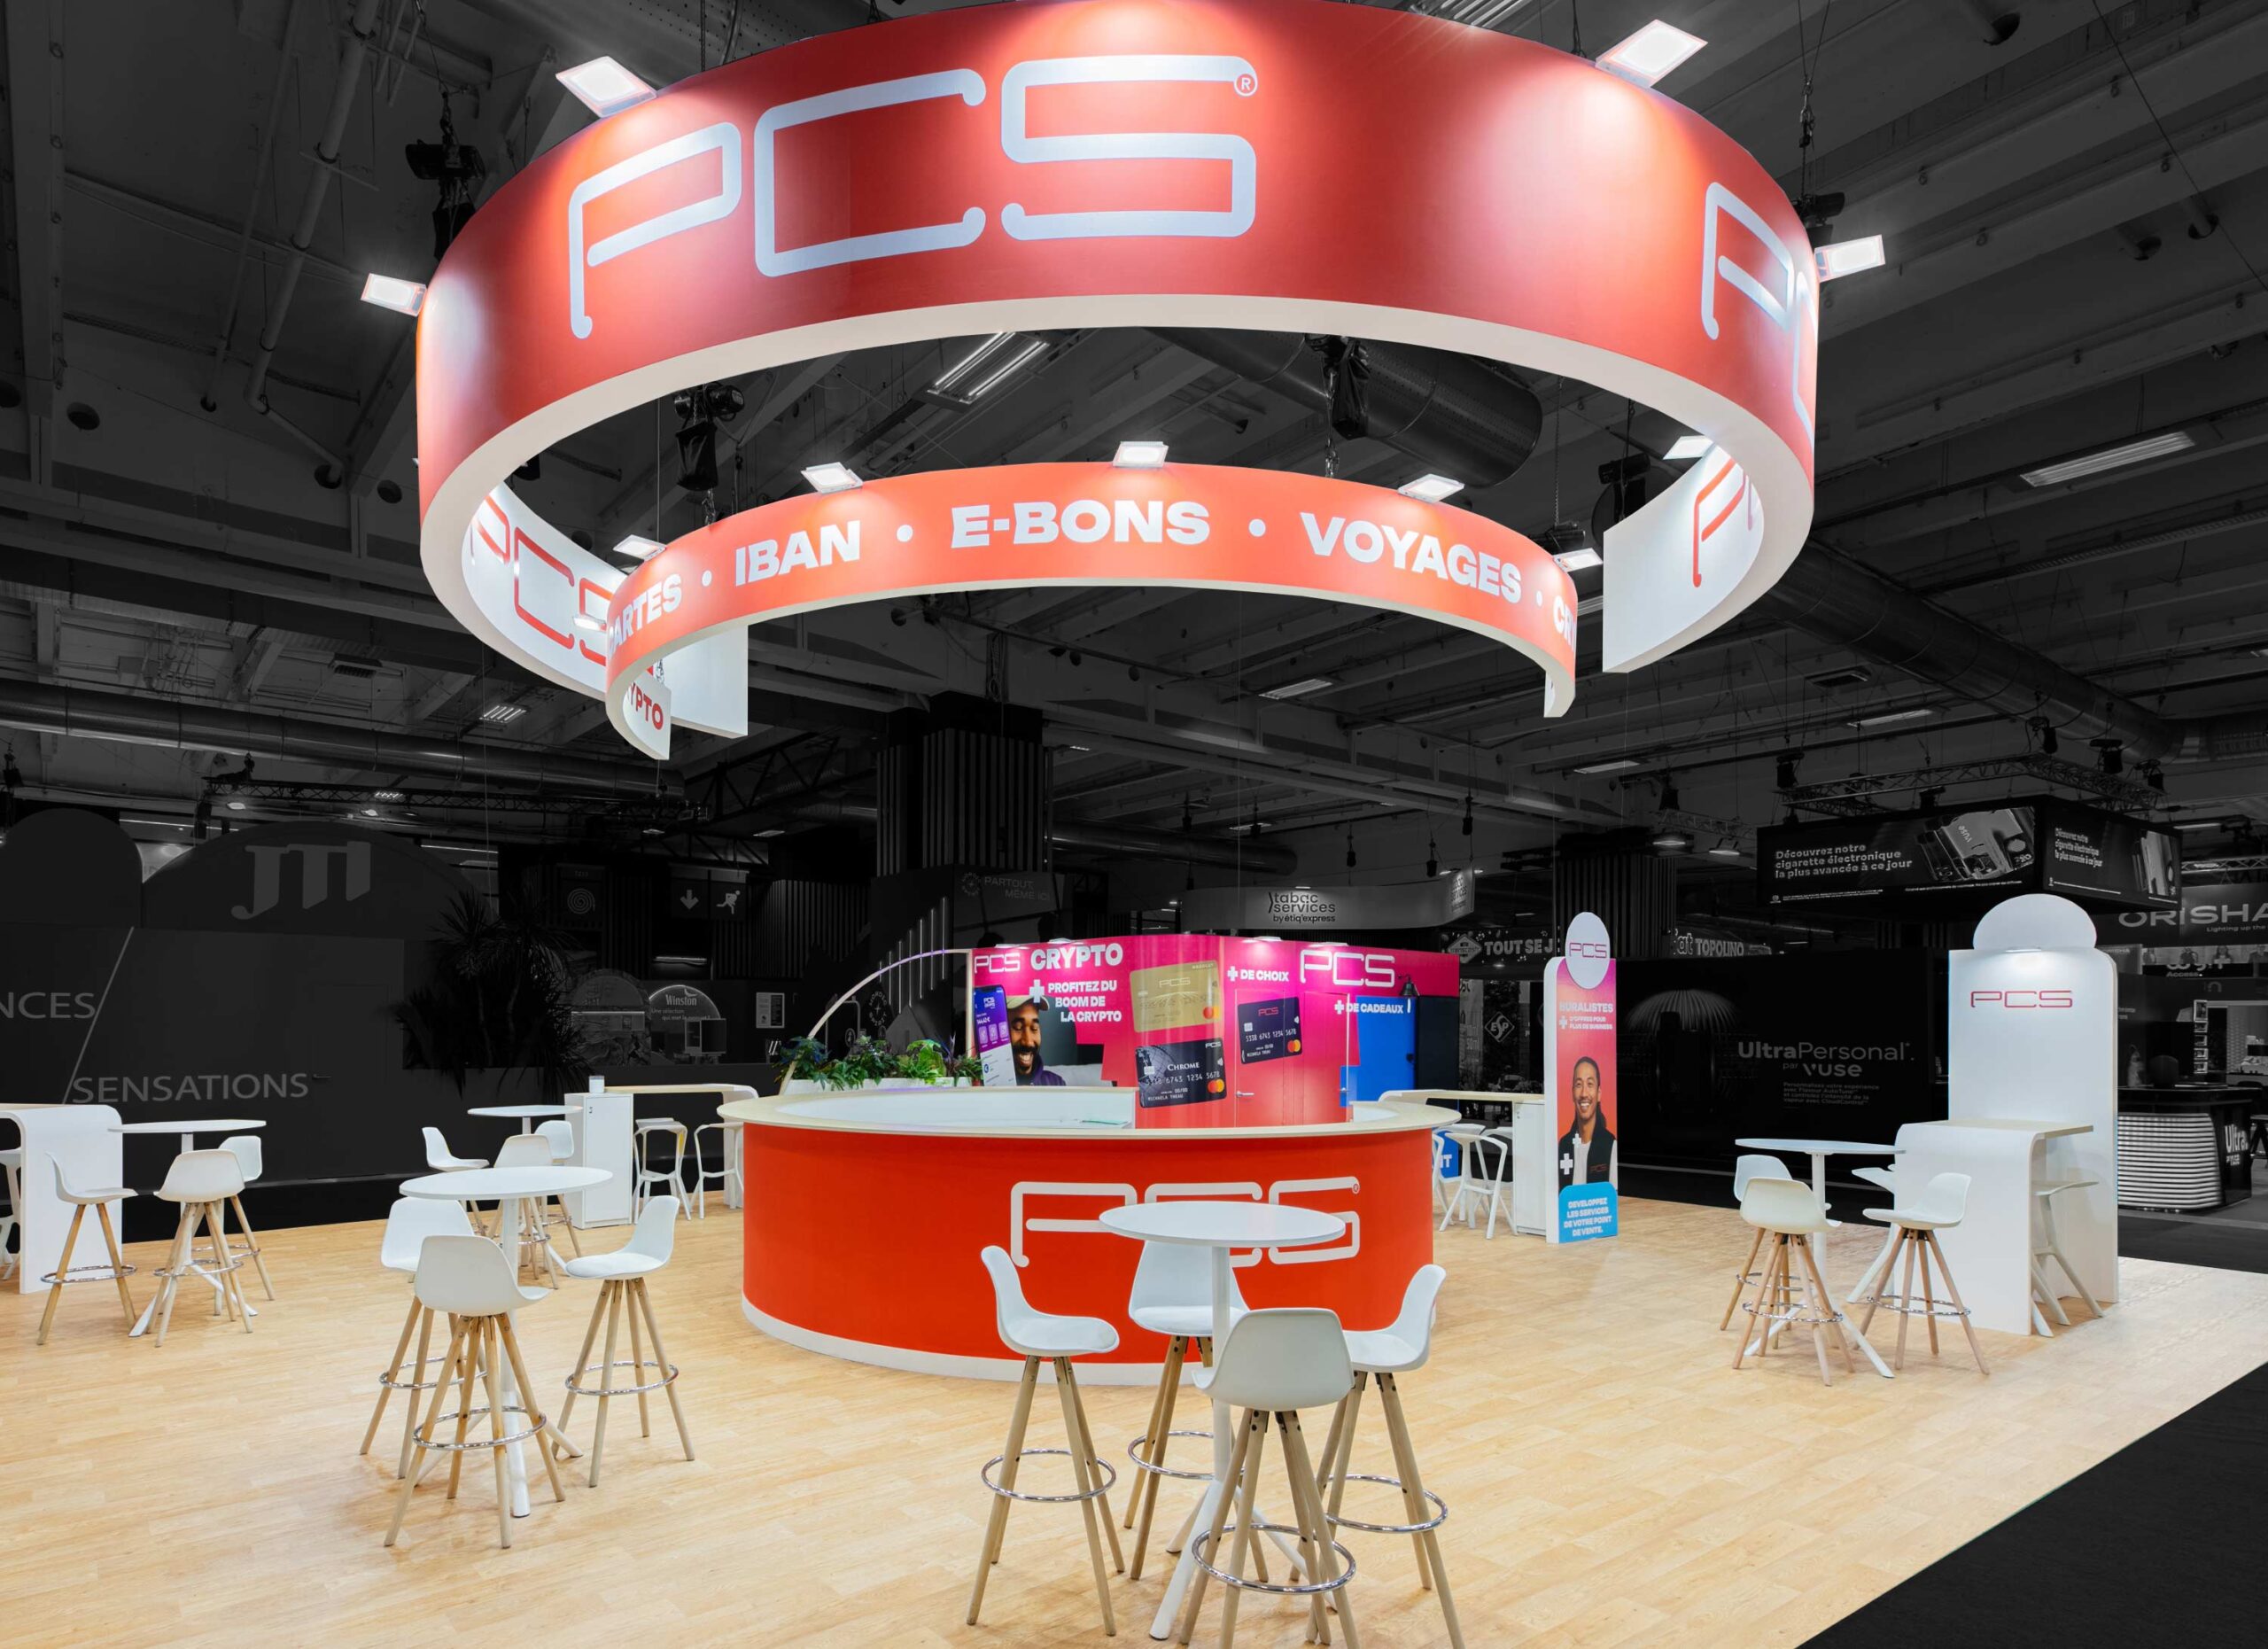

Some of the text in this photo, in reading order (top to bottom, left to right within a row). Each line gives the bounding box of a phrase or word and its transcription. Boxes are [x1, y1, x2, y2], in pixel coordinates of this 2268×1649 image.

[734, 519, 860, 587] IBAN
[950, 499, 1210, 546] E-BONS
[1299, 511, 1522, 604] VOYAGES
[1835, 844, 1866, 854] notre
[1775, 849, 1902, 870] cigarette électronique
[1775, 869, 1785, 879] la
[1787, 868, 1811, 880] plus
[1813, 863, 1859, 875] avancée
[1870, 861, 1884, 870] ce
[1885, 860, 1913, 871] jour
[230, 841, 371, 920] JTI
[1273, 891, 1318, 904] tabac
[1273, 901, 1336, 913] services
[1273, 914, 1284, 923] by
[1483, 940, 1523, 955] TOUT
[1525, 938, 1542, 954] SE
[1569, 942, 1607, 959] PCS
[1695, 937, 1744, 957] TOPOLINO
[975, 943, 1123, 974] PCS CRYPTO
[1300, 949, 1395, 988] PCS
[1159, 976, 1191, 988] PCS
[1240, 969, 1255, 980] DE
[1256, 970, 1289, 982] CHOIX
[1048, 980, 1117, 993] PROFITEZ DU
[665, 993, 698, 1007] Winston
[1055, 996, 1106, 1008] BOOM DE
[1971, 990, 2073, 1008] PCS
[1258, 1007, 1278, 1017] PCS
[1347, 1003, 1359, 1013] DE
[1361, 1003, 1403, 1014] CADEAUX
[1559, 1002, 1614, 1014] BURALISTES
[1060, 1011, 1122, 1023] LA CRYPTO
[1206, 1070, 1221, 1079] 5678
[72, 1072, 309, 1104] SENSATIONS
[1579, 1207, 1610, 1217] SERVICES
[1573, 1217, 1594, 1226] VOTRE
[1594, 1215, 1612, 1225] POINT
[1573, 1228, 1581, 1237] DE
